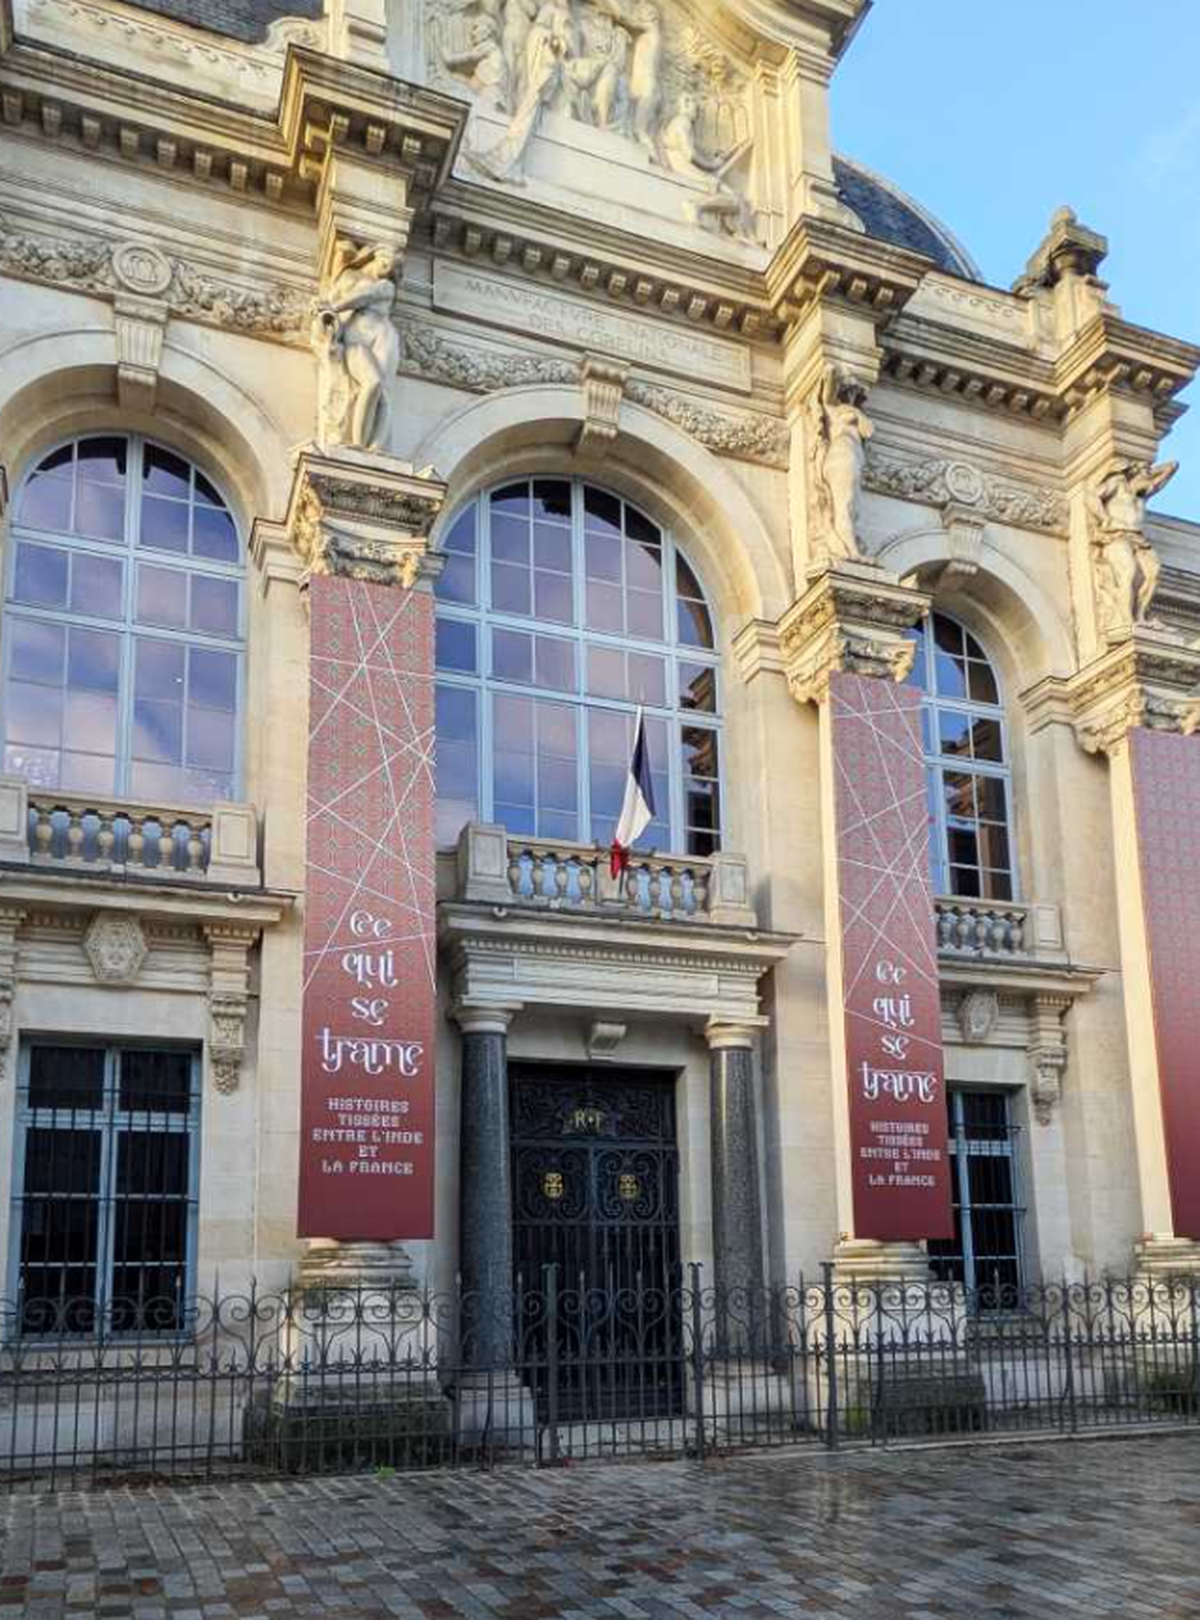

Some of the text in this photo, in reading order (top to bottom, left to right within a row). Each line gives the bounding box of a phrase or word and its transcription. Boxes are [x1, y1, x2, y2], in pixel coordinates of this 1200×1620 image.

[350, 910, 392, 937] Ce
[342, 950, 399, 989] qui
[876, 960, 907, 984] Ce
[351, 997, 389, 1026] se
[873, 994, 915, 1028] qui
[316, 1027, 424, 1077] trame
[881, 1034, 909, 1060] se
[858, 1061, 937, 1103] trame
[327, 1097, 410, 1114] HISTOIRES
[312, 1128, 424, 1145] ENTRE L'INDE
[358, 1144, 380, 1158] ET
[860, 1146, 900, 1159] ENTRE
[322, 1160, 414, 1175] LA FRANCE
[894, 1161, 910, 1173] ET
[869, 1174, 936, 1187] LA FRANCE
